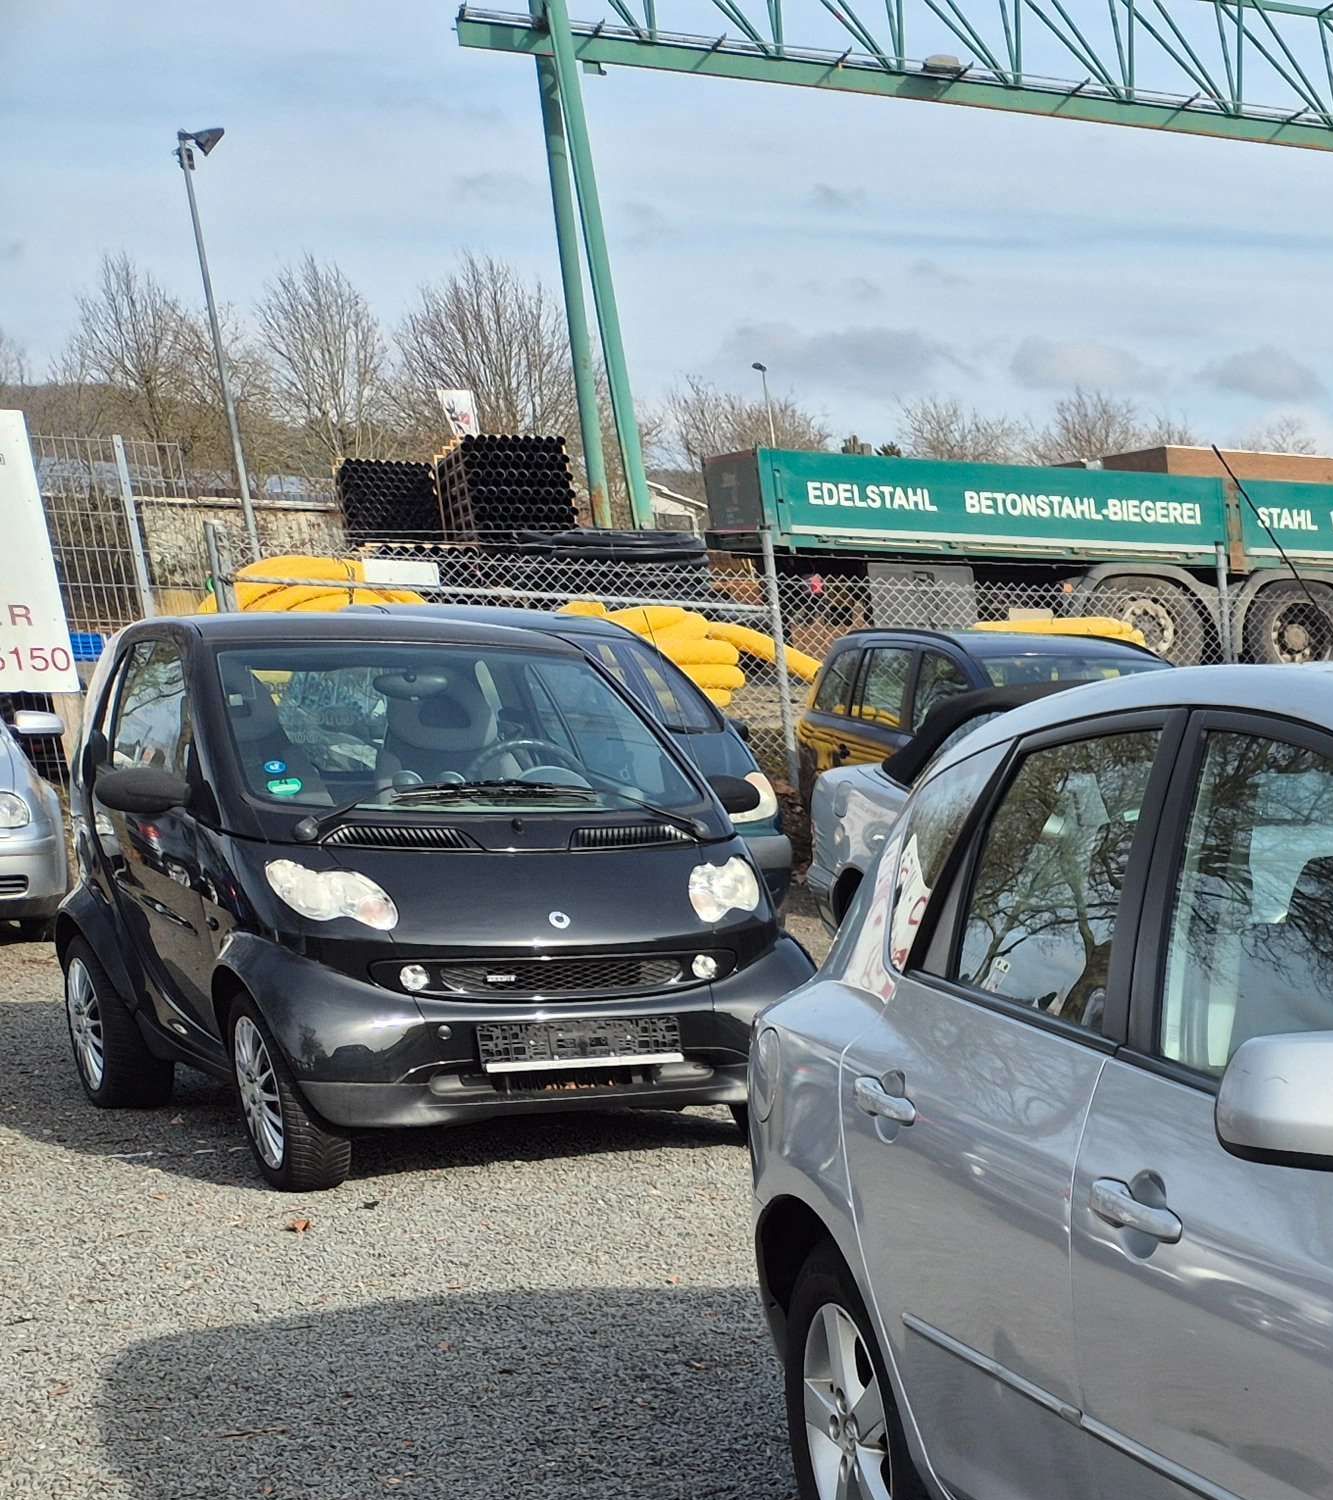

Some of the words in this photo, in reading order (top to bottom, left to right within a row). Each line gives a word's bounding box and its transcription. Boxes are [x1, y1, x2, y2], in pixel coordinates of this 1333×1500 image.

[806, 481, 938, 512] EDELSTAHL
[964, 490, 1202, 525] BETONSTAHL-BIEGEREI
[1256, 506, 1319, 532] STAHL
[0, 647, 70, 671] 150
